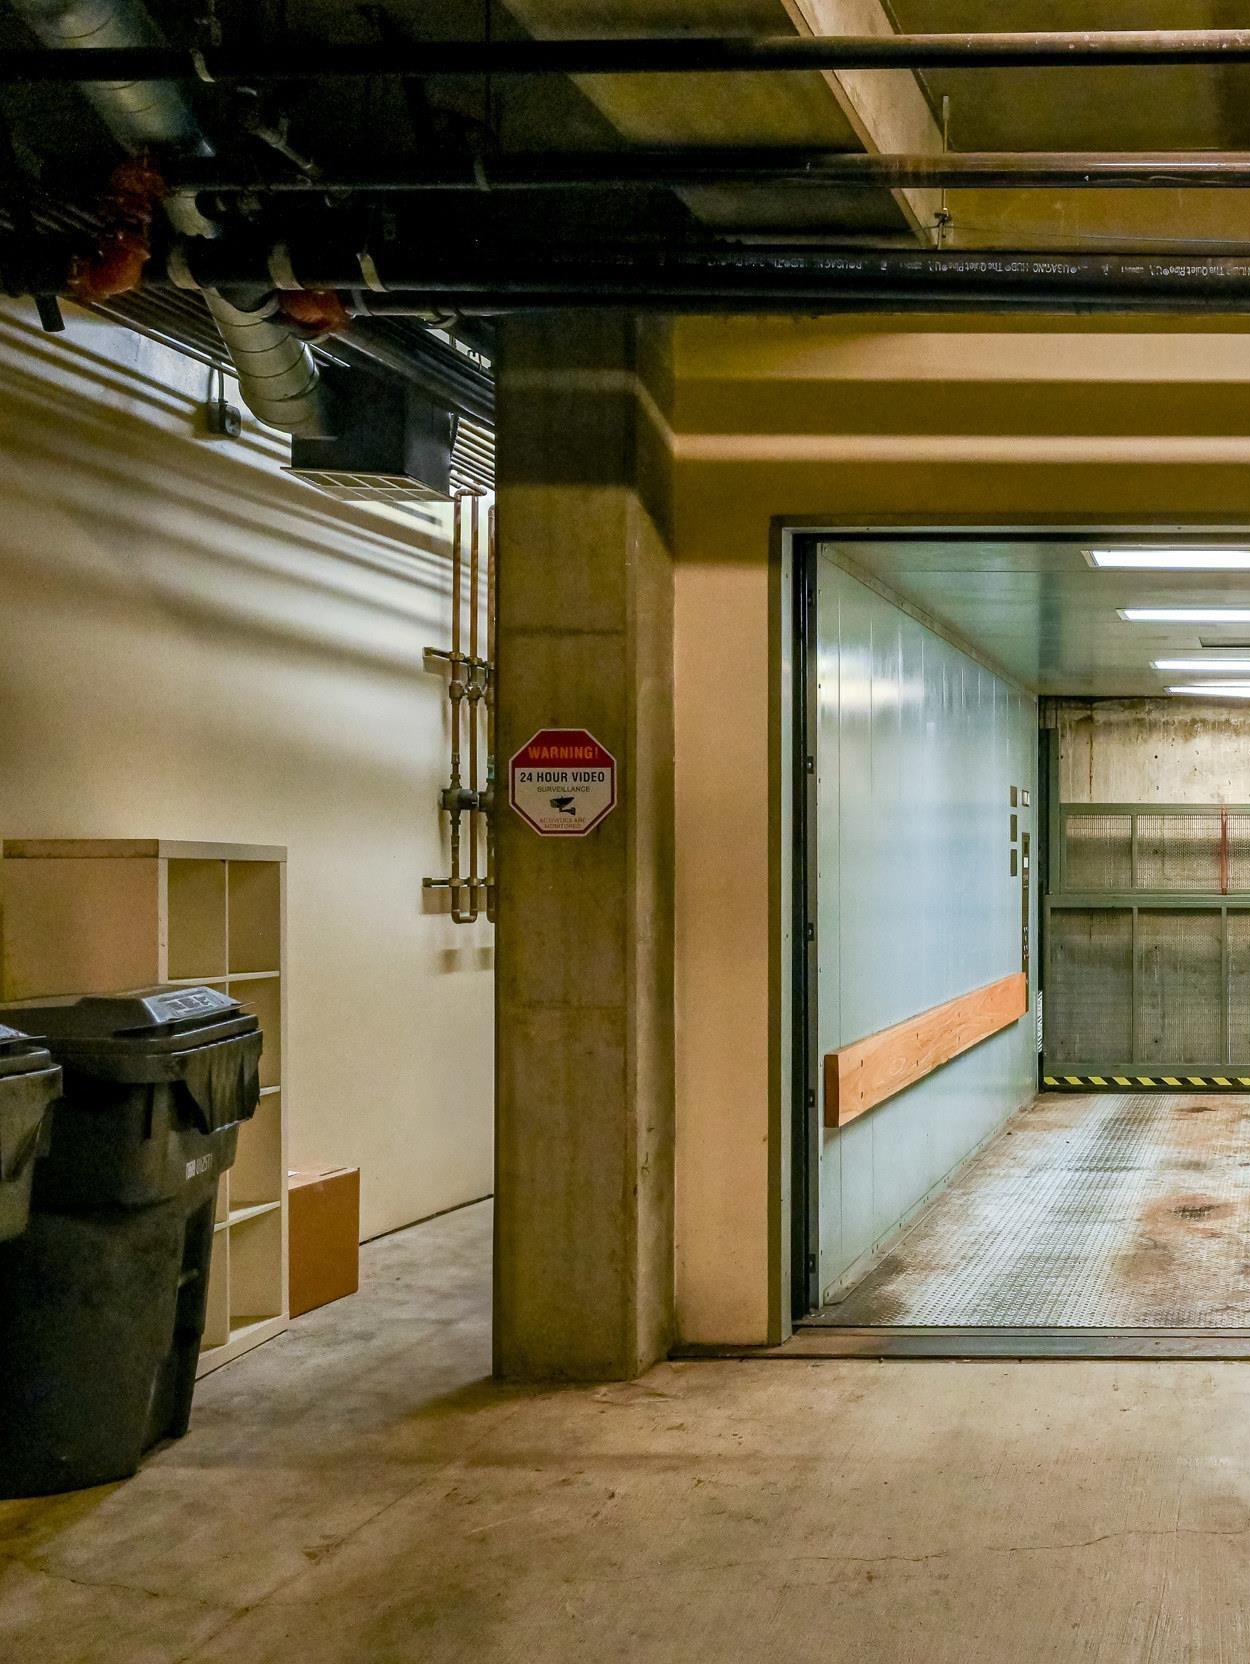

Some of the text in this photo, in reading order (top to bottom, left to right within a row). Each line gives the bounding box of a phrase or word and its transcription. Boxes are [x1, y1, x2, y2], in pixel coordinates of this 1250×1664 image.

[528, 746, 599, 759] WARNING!
[520, 771, 605, 783] 24 HOUR VIDEO
